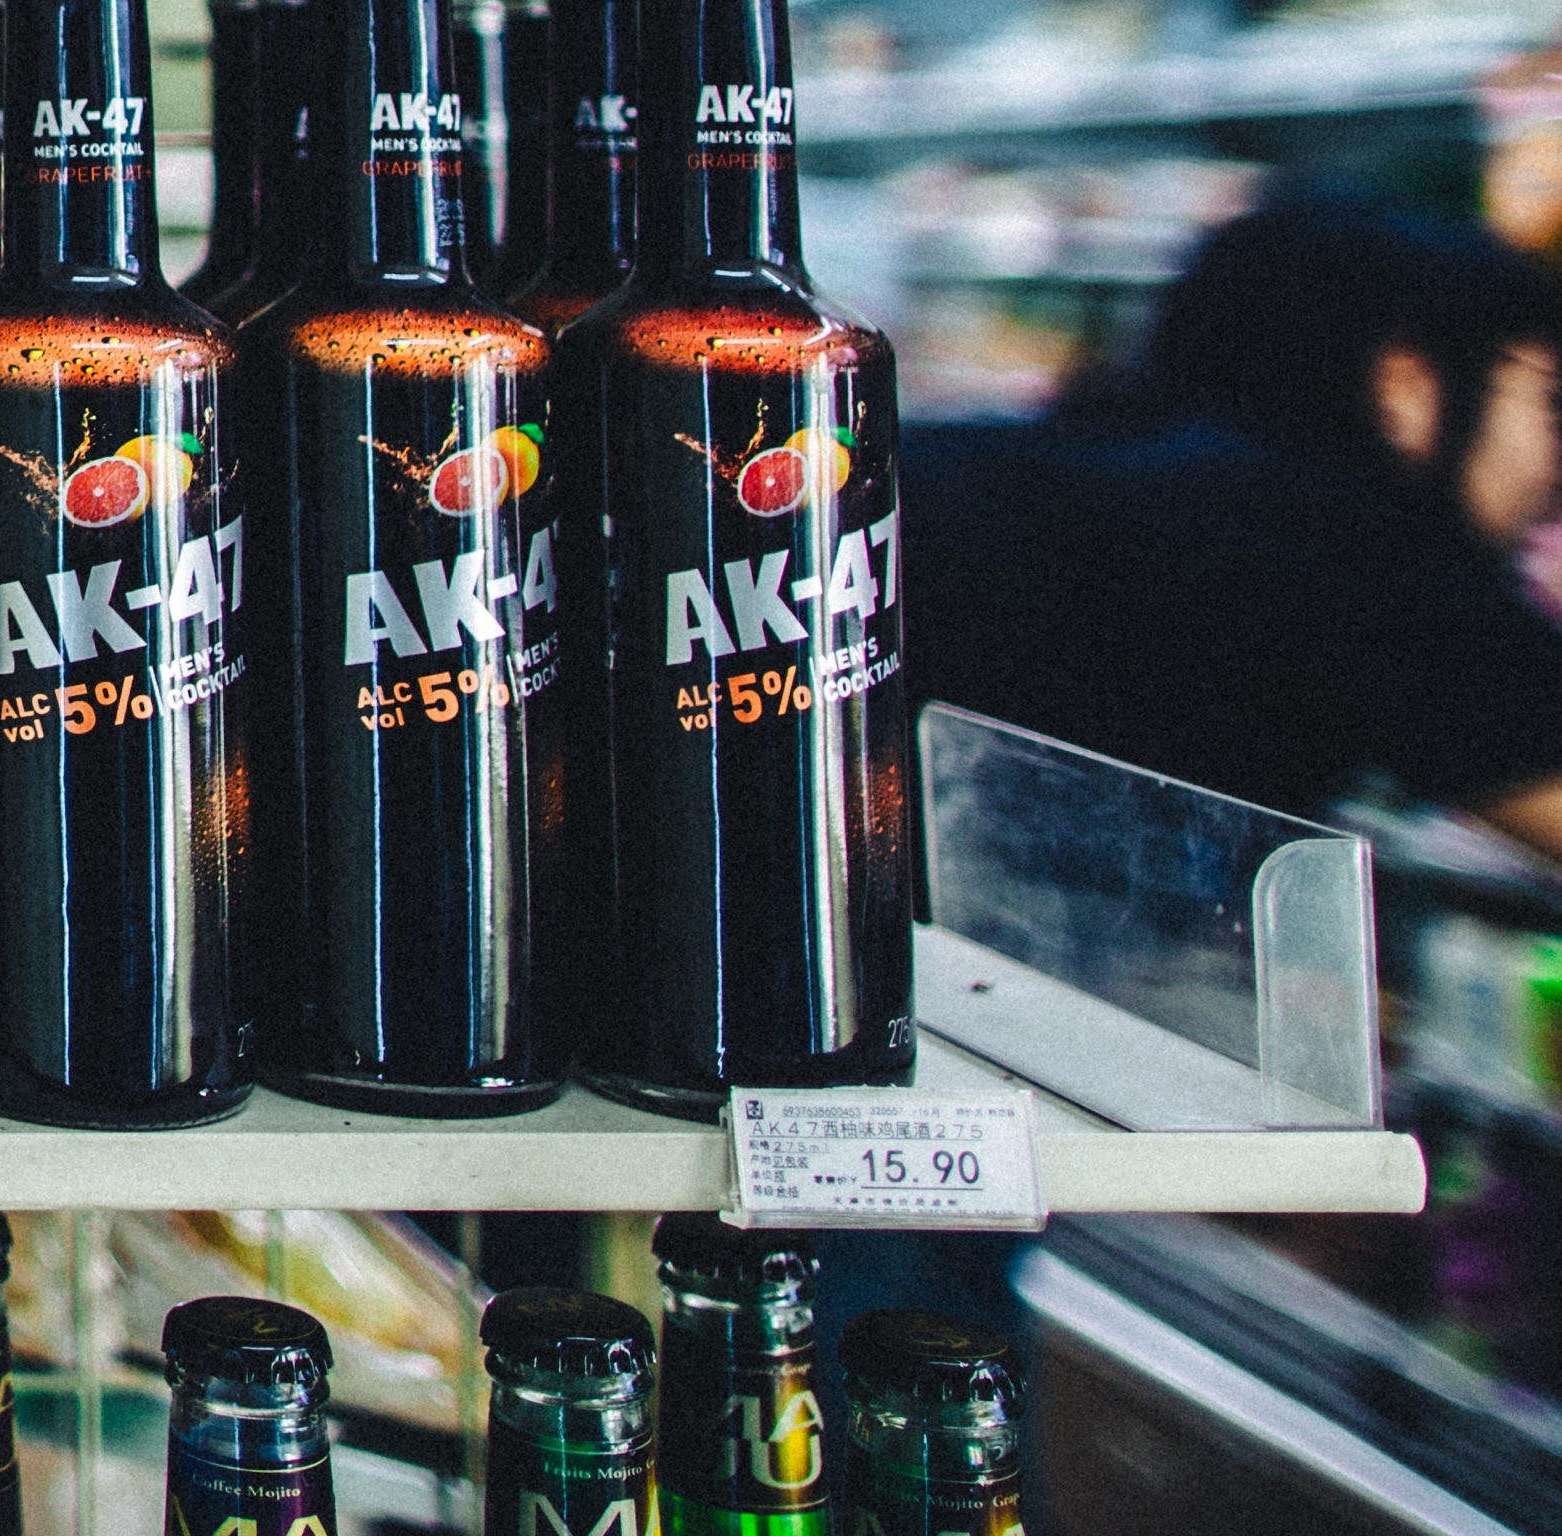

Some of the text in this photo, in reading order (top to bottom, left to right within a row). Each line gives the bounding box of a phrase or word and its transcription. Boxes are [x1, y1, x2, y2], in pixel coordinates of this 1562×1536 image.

[33, 97, 144, 138] AK-47
[369, 92, 462, 132] AK-47
[695, 84, 794, 125] AK-47
[34, 142, 145, 159] MEN'S COCKTAIL
[371, 137, 419, 153] MEN'S
[696, 130, 793, 146] MEN'S COCKTAIL
[344, 517, 560, 666] AK-4
[666, 508, 898, 666] AK-47
[159, 641, 226, 685] MEN'S
[516, 631, 559, 674] MEN'S
[818, 636, 879, 677] MEN'S
[166, 653, 247, 710] COCKTAIL
[357, 681, 413, 709] ALC
[417, 664, 511, 723] 5%
[677, 681, 723, 710] ALC
[727, 665, 813, 725] 5%
[822, 651, 901, 703] COCKTAIL
[0, 693, 51, 721] ALC
[54, 674, 154, 735] 5%
[360, 707, 405, 731] vol
[679, 707, 717, 732] vol
[3, 719, 44, 743] vol
[861, 1148, 981, 1184] 15.90
[596, 1464, 643, 1482] Mojito
[247, 1485, 301, 1501] Mojito
[927, 1493, 985, 1511] Mojito
